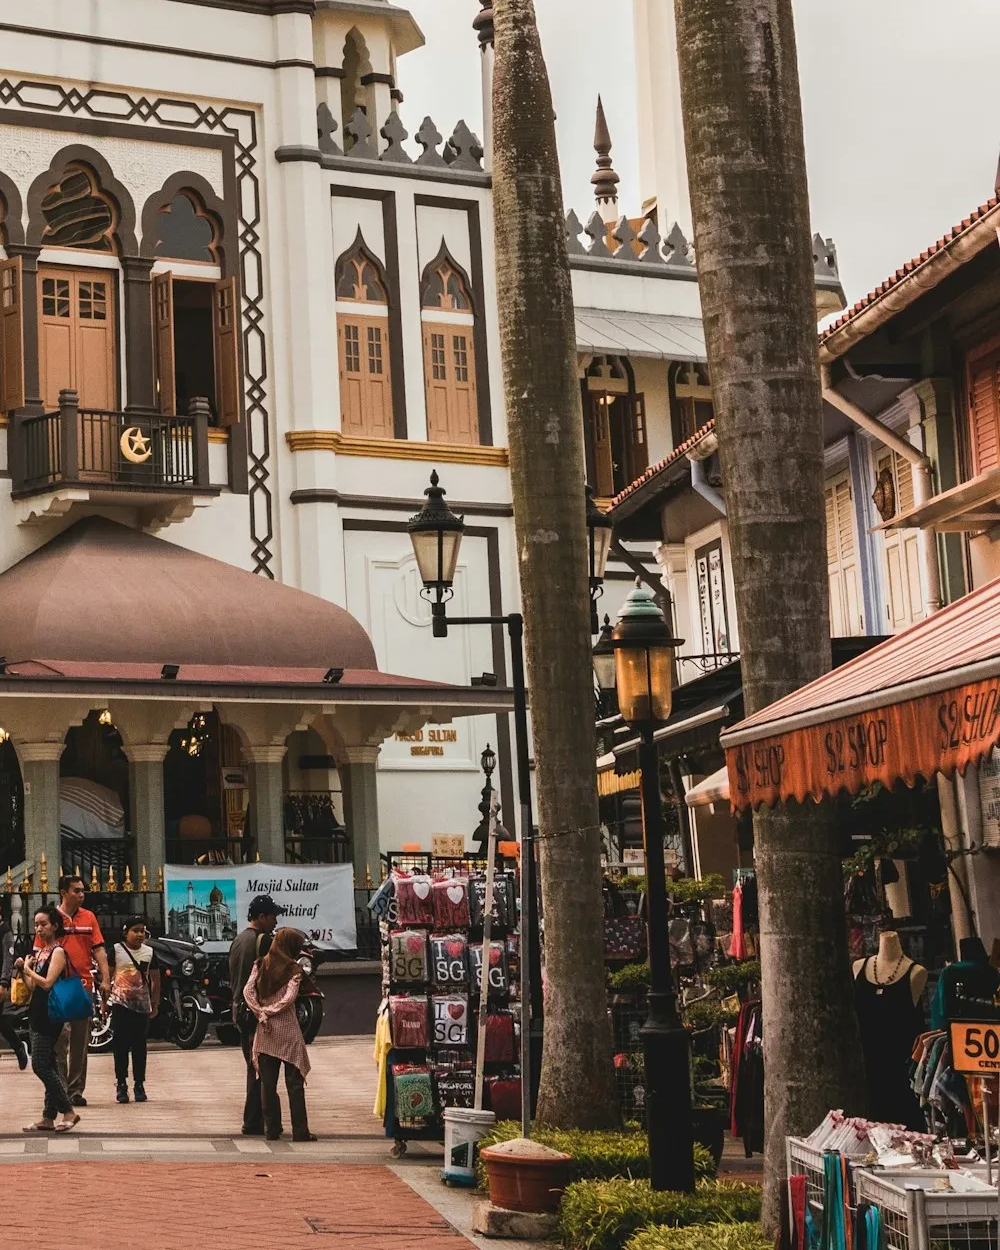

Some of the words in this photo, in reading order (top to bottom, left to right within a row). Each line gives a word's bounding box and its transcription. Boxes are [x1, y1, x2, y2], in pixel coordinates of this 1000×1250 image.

[428, 729, 457, 743] SULTAN
[848, 719, 887, 768] SHOP
[755, 745, 785, 788] SHOP
[246, 879, 283, 896] Masjid
[284, 878, 319, 893] Sultan
[433, 940, 444, 960] I
[395, 957, 424, 979] SG
[437, 960, 466, 982] SG
[435, 1002, 446, 1021] I
[434, 1022, 466, 1043] SG
[964, 1027, 1000, 1059] 50
